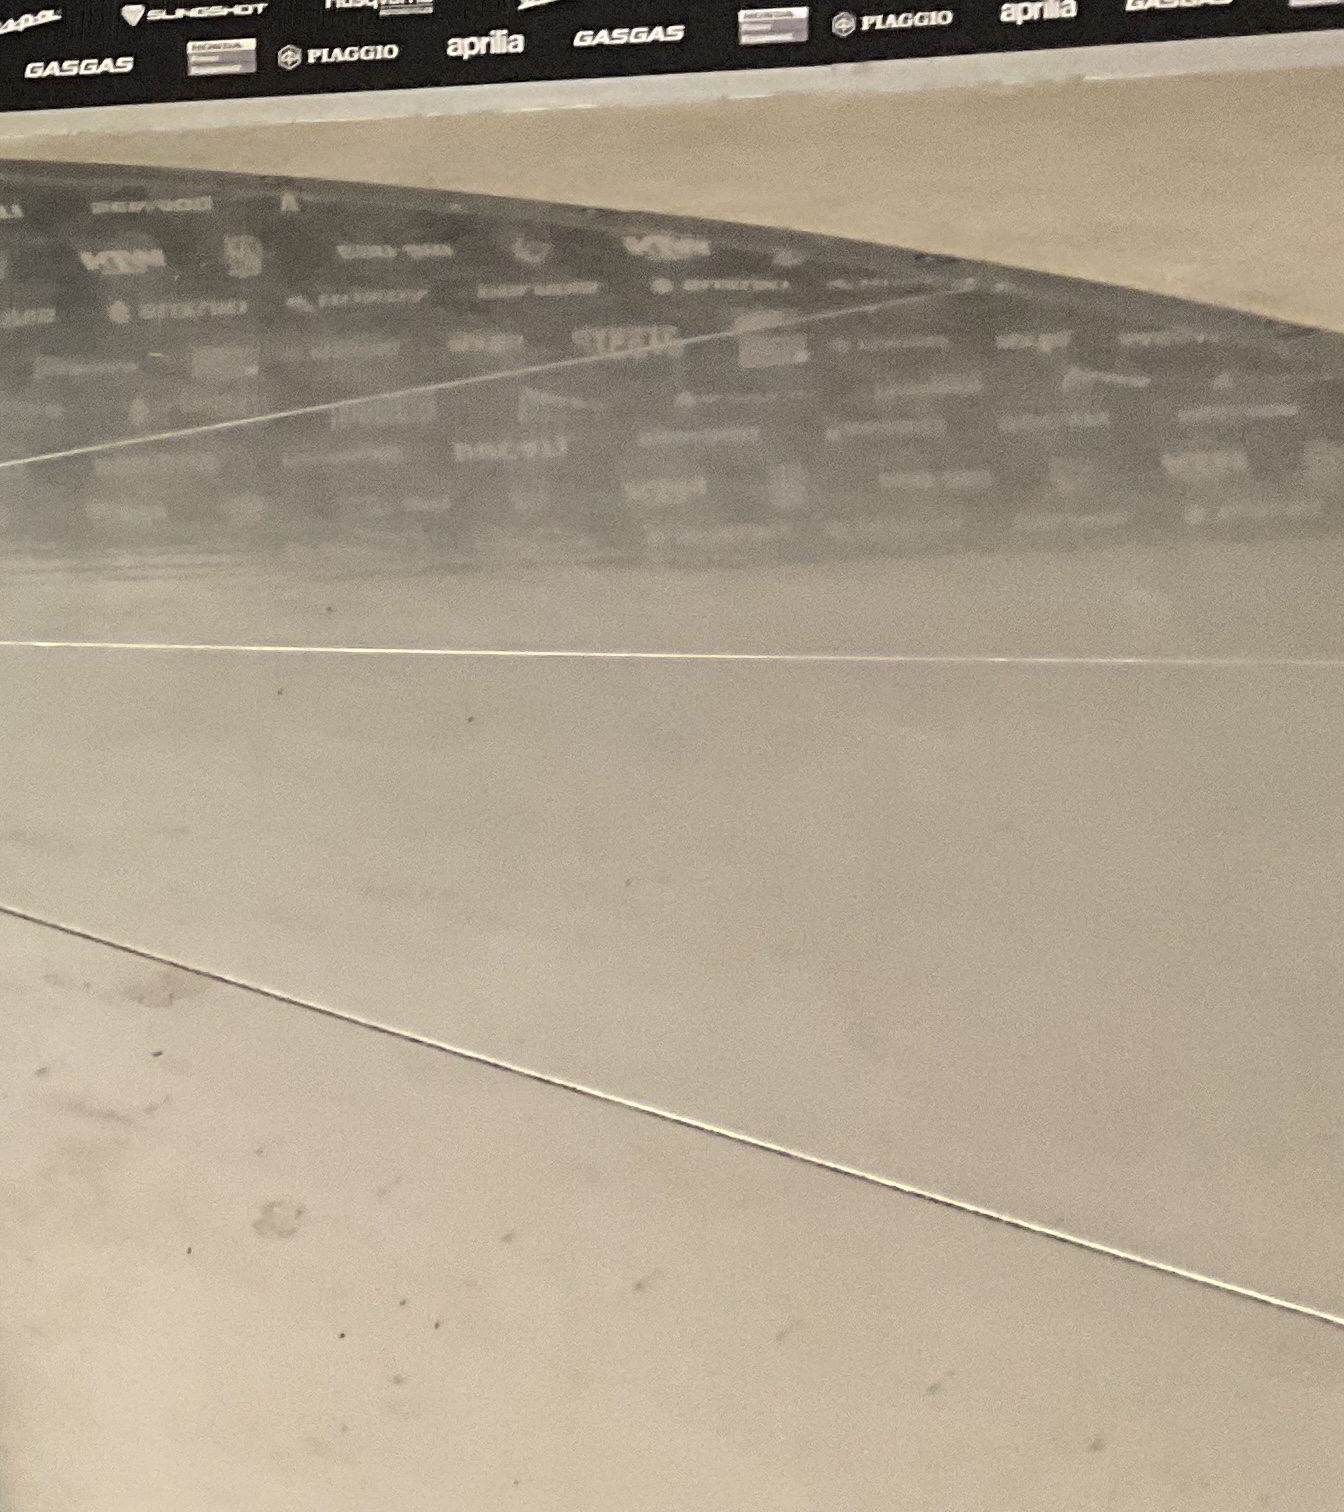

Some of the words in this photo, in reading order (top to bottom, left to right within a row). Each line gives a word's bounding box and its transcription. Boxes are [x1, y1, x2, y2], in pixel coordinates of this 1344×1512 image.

[860, 11, 953, 30] PIAGGIO
[447, 29, 524, 60] aprilia
[573, 25, 685, 46] GASGAS
[308, 44, 399, 63] PIAGGIO
[25, 57, 134, 78] GASGAS
